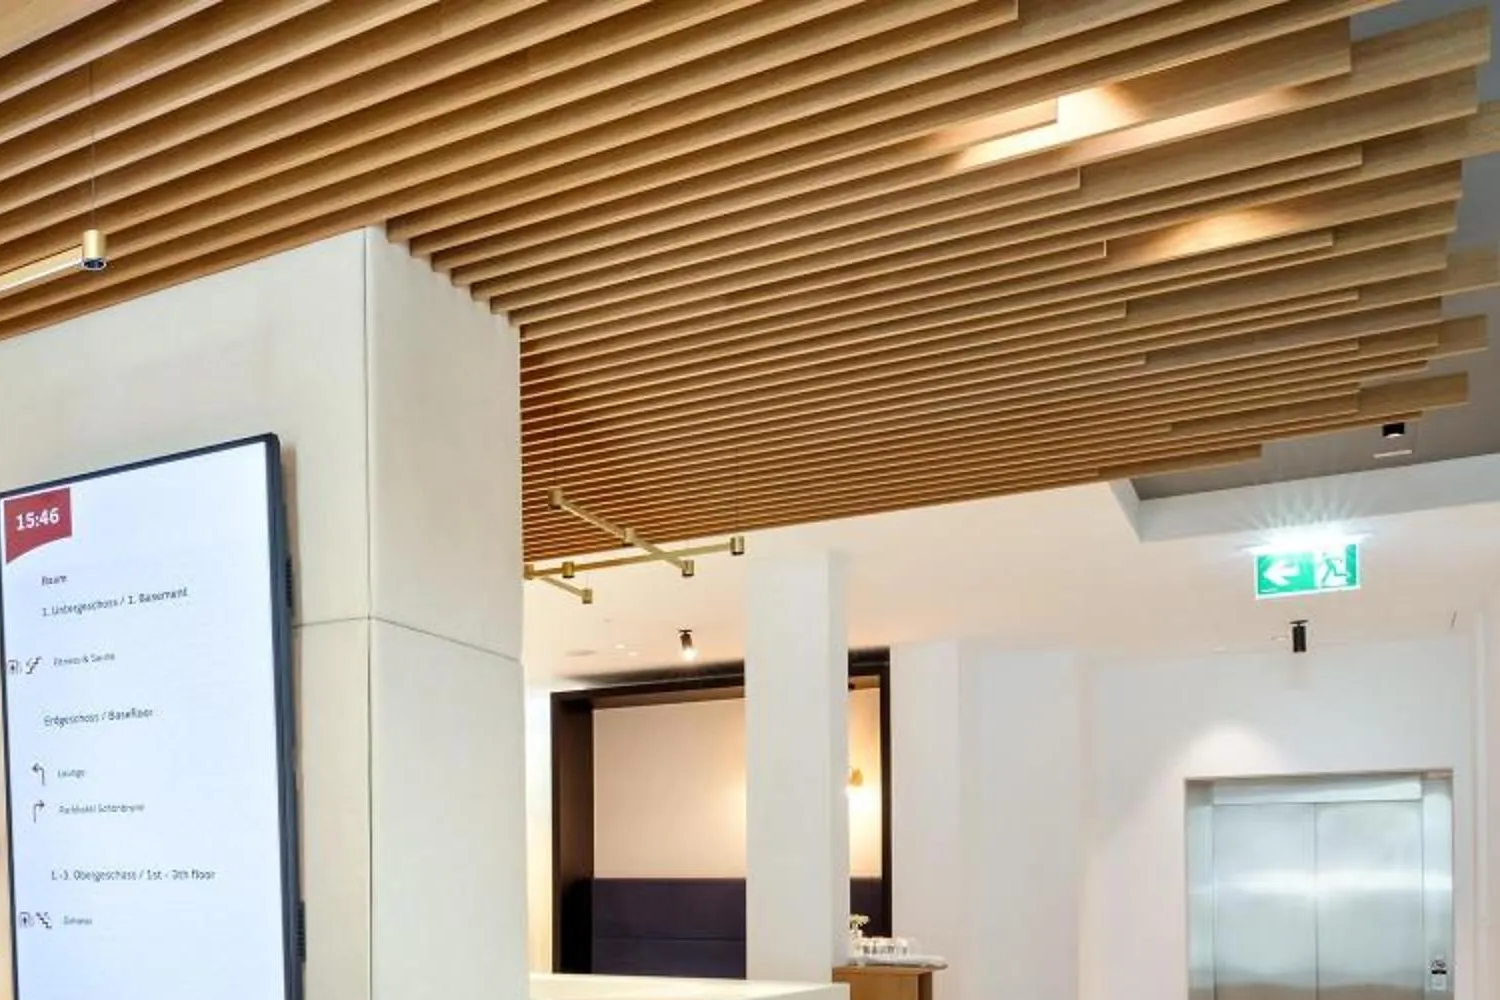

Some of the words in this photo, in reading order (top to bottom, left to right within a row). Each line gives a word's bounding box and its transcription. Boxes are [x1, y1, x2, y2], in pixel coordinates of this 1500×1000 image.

[16, 507, 60, 531] 15:46
[51, 599, 118, 616] Untergeschoss
[138, 586, 189, 603] Basement
[43, 712, 99, 729] Erdgeschoss
[73, 868, 137, 883] Obergeschoss
